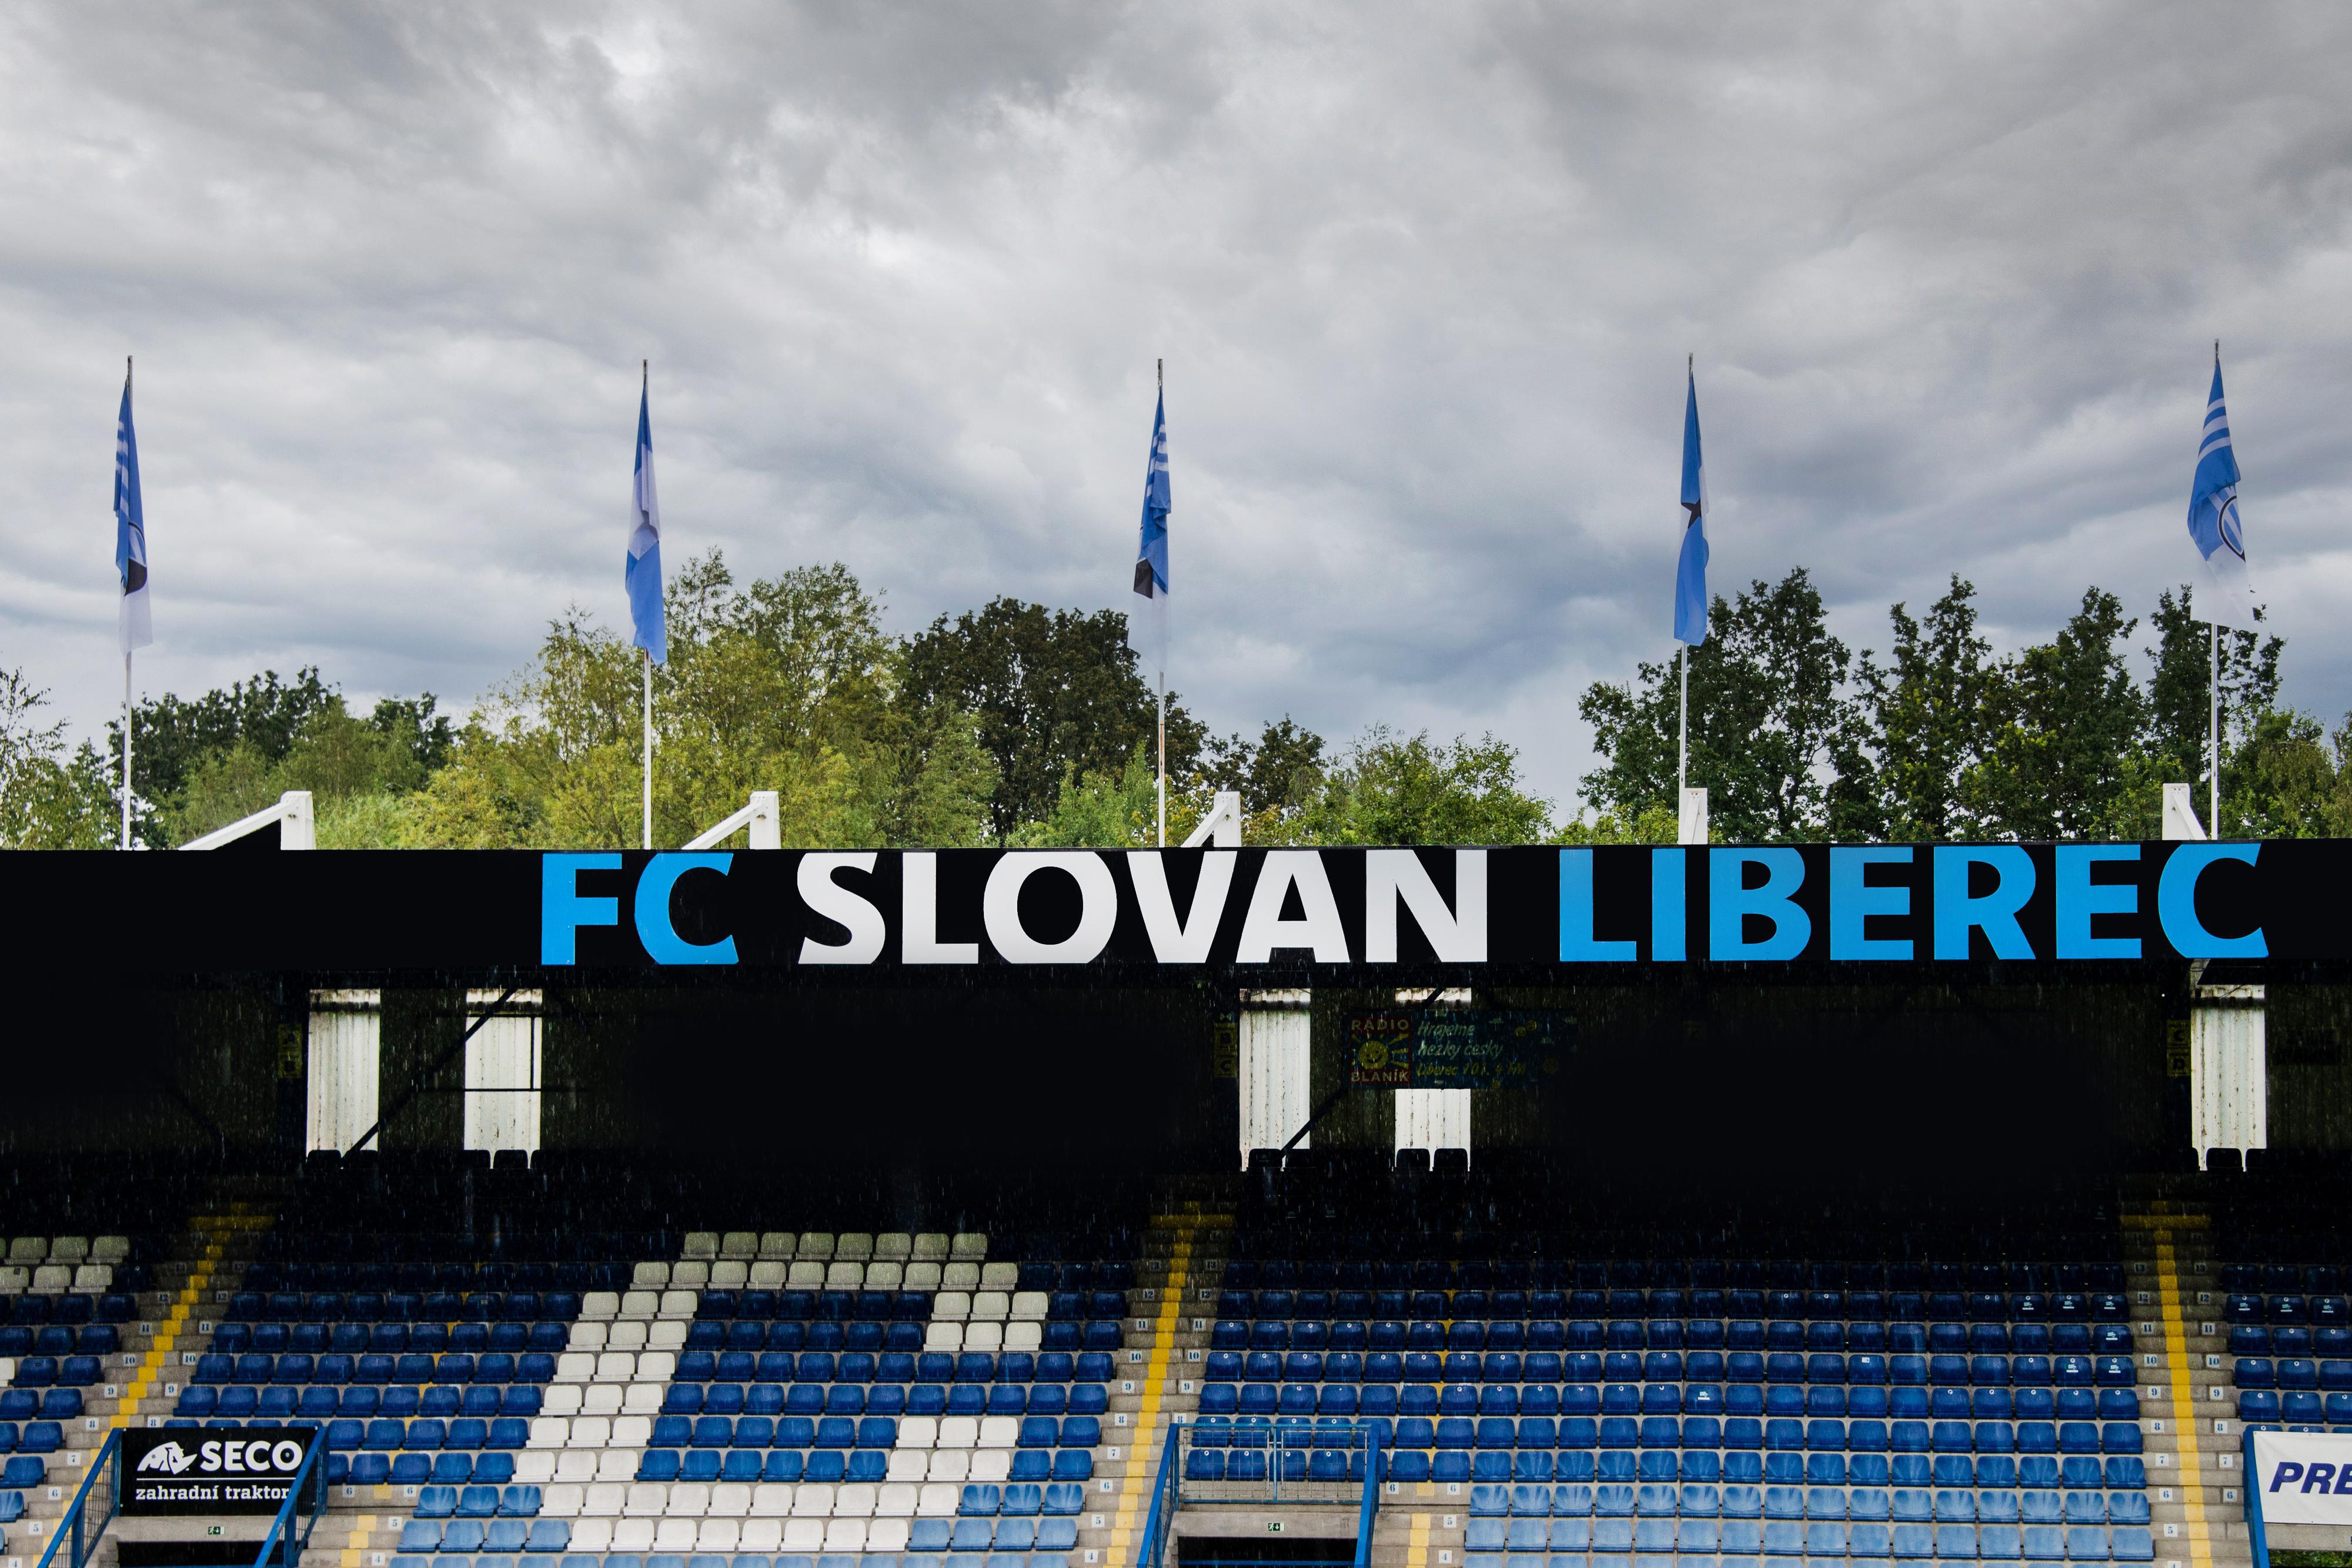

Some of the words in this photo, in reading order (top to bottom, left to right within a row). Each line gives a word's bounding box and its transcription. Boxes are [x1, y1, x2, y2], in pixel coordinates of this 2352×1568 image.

[542, 853, 739, 965] FC
[797, 850, 1488, 964] SLOVAN
[1559, 843, 2269, 962] LIBEREC
[200, 1440, 303, 1471] SECO
[136, 1485, 219, 1500] zahradní
[225, 1485, 292, 1500] traktor
